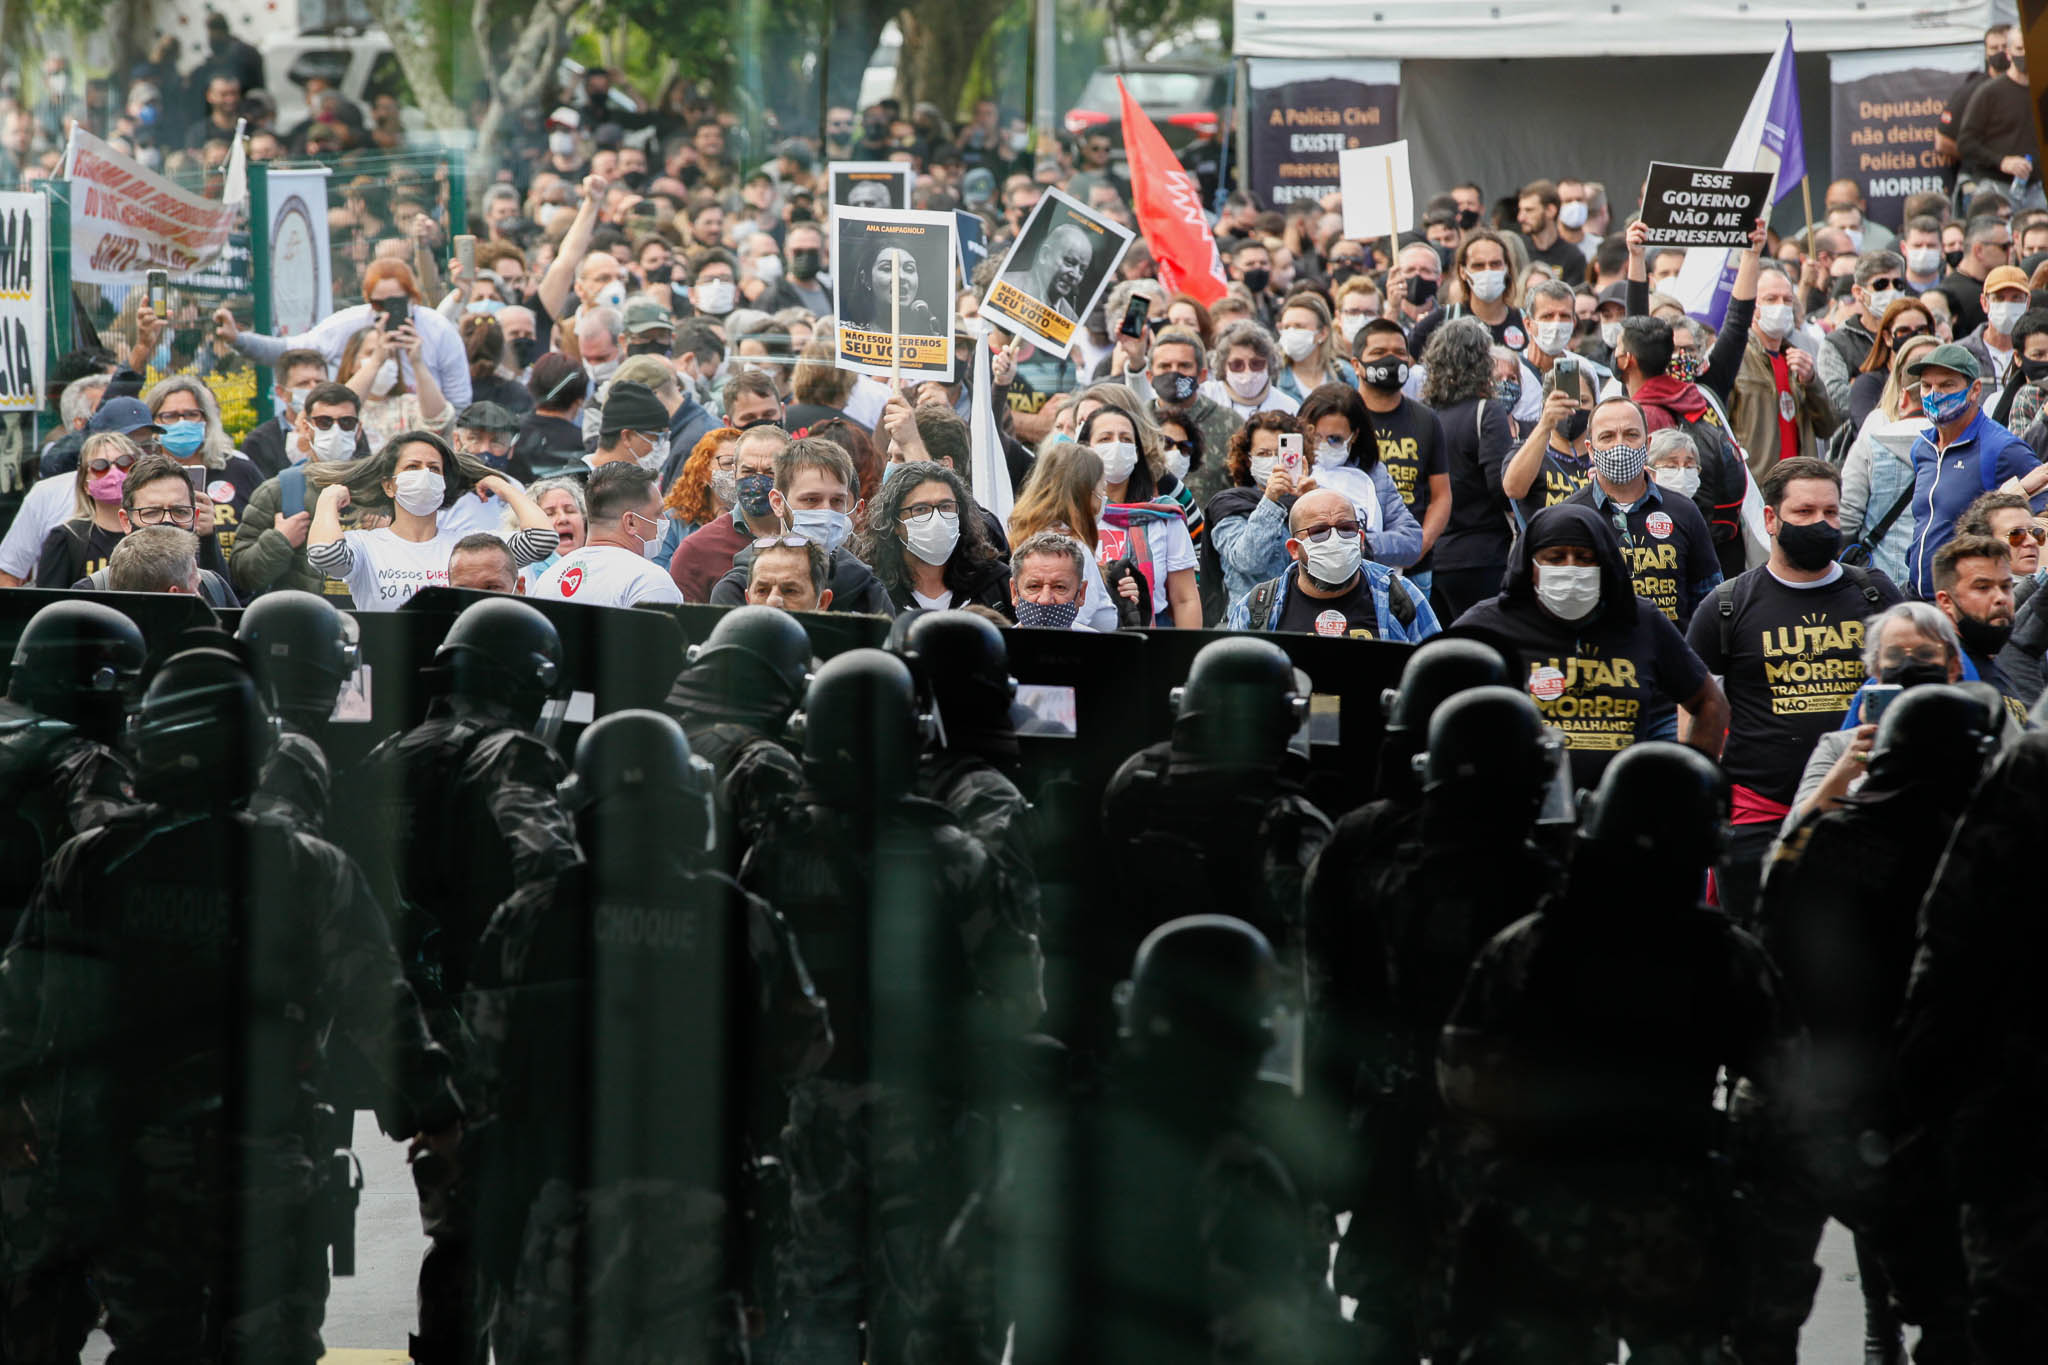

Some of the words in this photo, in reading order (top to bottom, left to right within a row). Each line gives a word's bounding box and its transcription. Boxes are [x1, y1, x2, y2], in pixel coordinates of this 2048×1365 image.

[1269, 108, 1284, 126] A
[1343, 106, 1380, 126] Civil
[1290, 133, 1346, 152] EXISTE
[1851, 126, 1884, 145] não
[1887, 124, 1938, 144] deixe
[1860, 151, 1916, 171] Polícia
[1691, 173, 1733, 189] ESSE
[1662, 190, 1750, 213] GOVERNO
[1669, 208, 1709, 226] NÃO
[1713, 213, 1741, 227] ME
[866, 224, 880, 232] ANA
[1646, 228, 1747, 243] REPRESENTA
[996, 292, 1018, 310] SEU
[1020, 305, 1050, 328] VOTO
[845, 331, 865, 342] NÃO
[846, 341, 872, 355] SEU
[1007, 391, 1047, 414] TAR
[1377, 437, 1418, 461] TAR
[1388, 464, 1418, 480] RER
[1619, 544, 1678, 573] TAR
[1632, 577, 1677, 595] RRER
[1762, 621, 1866, 657] LUTAR
[1797, 652, 1815, 661] OU
[1531, 657, 1640, 688] UTAR
[1765, 658, 1864, 684] MORRER
[1776, 698, 1808, 713] NÃO
[594, 904, 696, 948] CHOQUE
